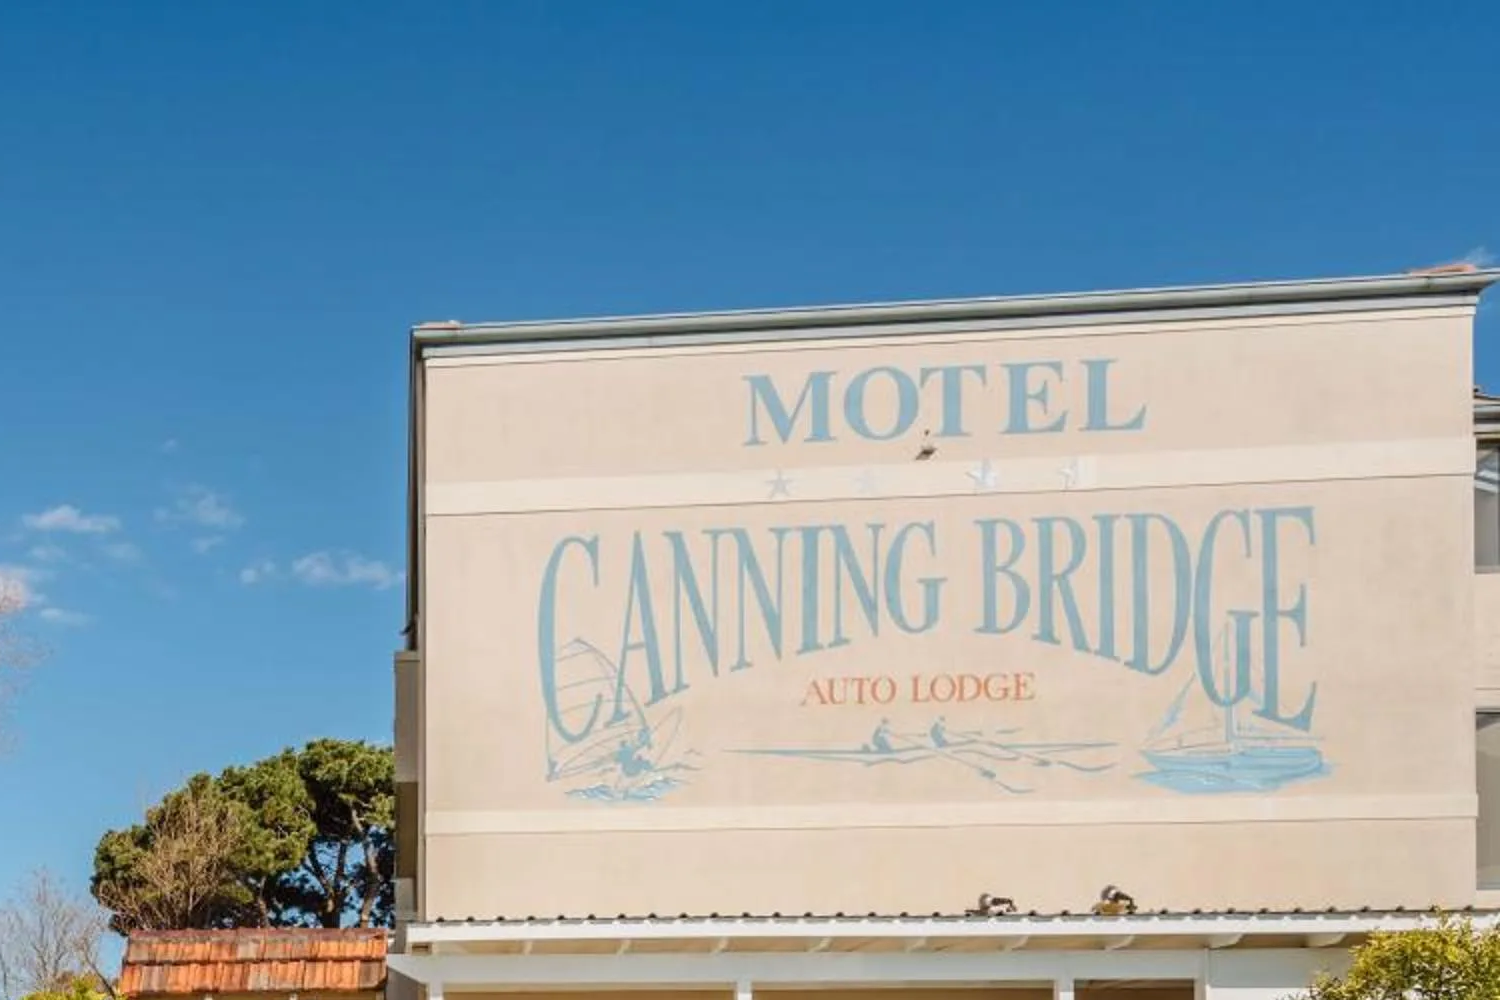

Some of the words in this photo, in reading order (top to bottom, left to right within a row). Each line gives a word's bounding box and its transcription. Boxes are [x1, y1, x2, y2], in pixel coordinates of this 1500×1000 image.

[744, 359, 1147, 446] MOTEL
[539, 519, 947, 743] CANNING
[974, 507, 1318, 731] BRIDGE
[801, 675, 897, 706] AUTO
[911, 672, 1036, 703] LODGE
